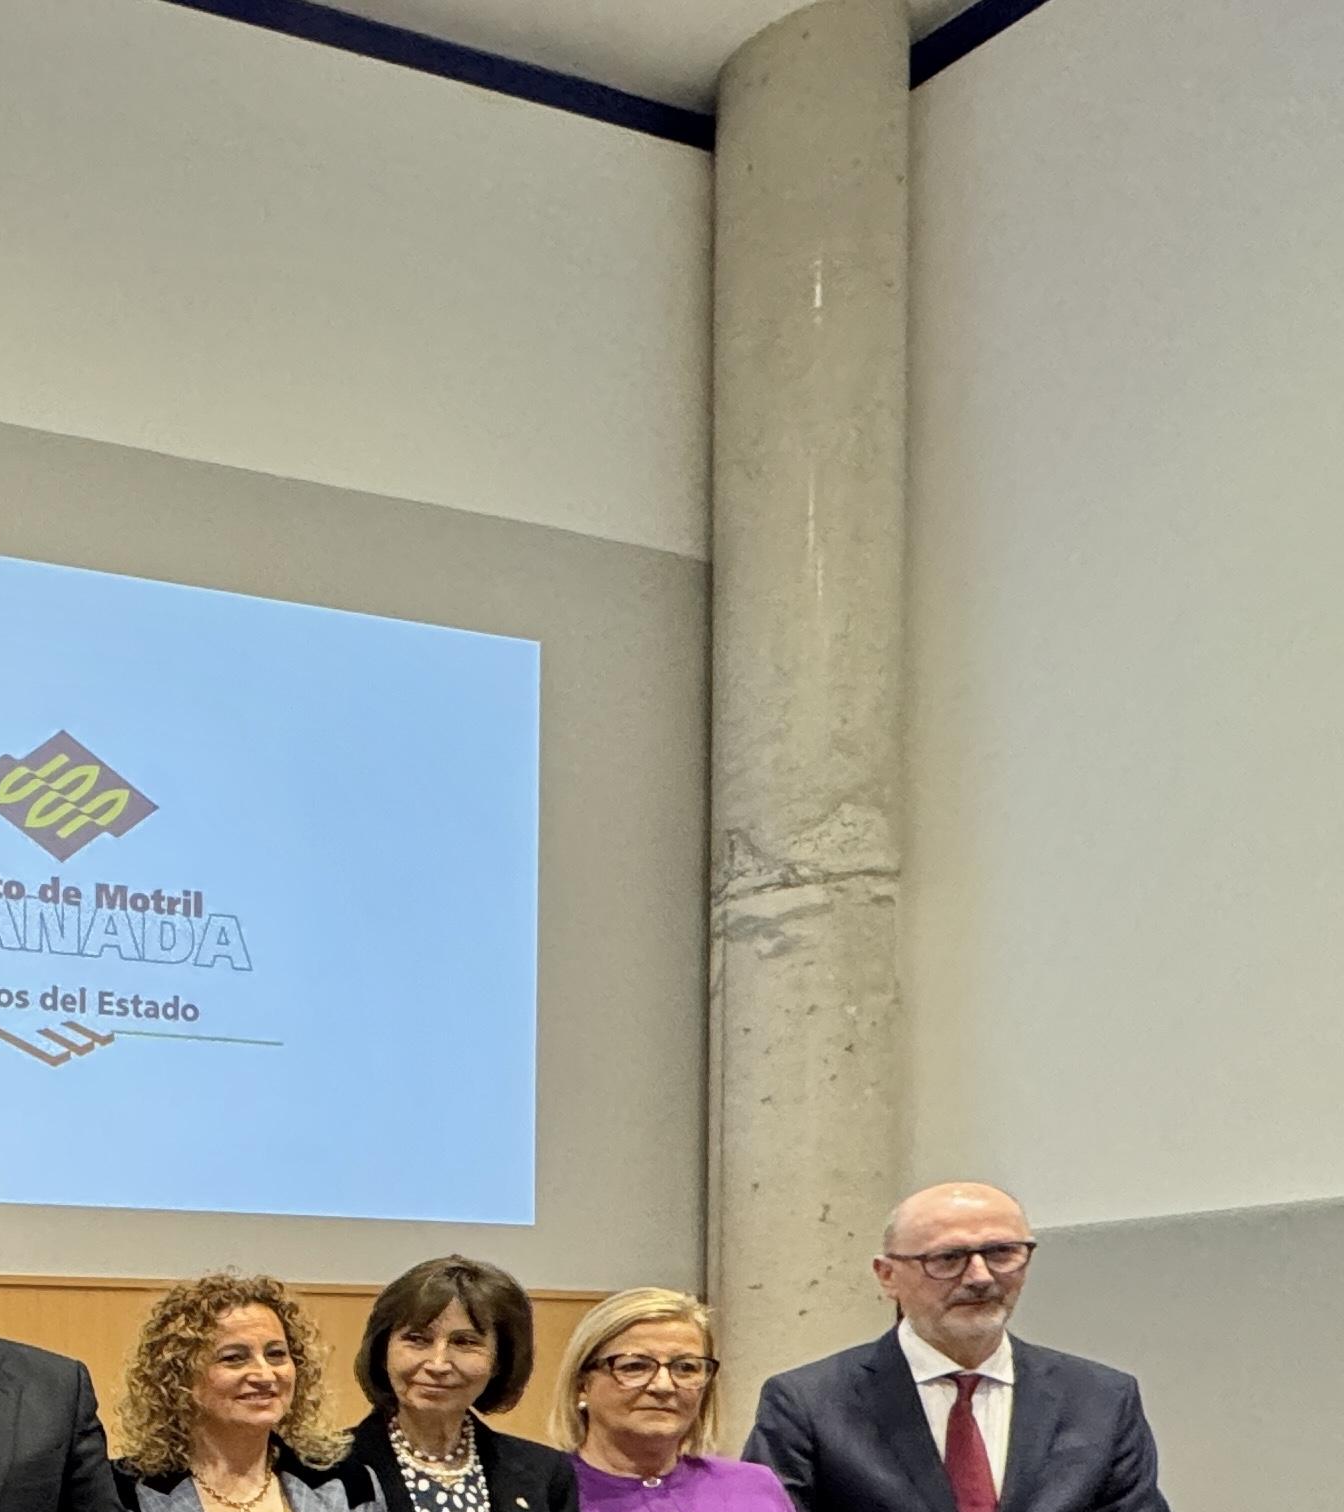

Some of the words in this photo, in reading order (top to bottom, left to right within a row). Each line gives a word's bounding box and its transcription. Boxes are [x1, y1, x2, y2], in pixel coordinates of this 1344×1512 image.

[38, 877, 82, 906] de
[95, 883, 204, 918] Motril
[39, 987, 86, 1013] del
[98, 991, 200, 1022] Estado
